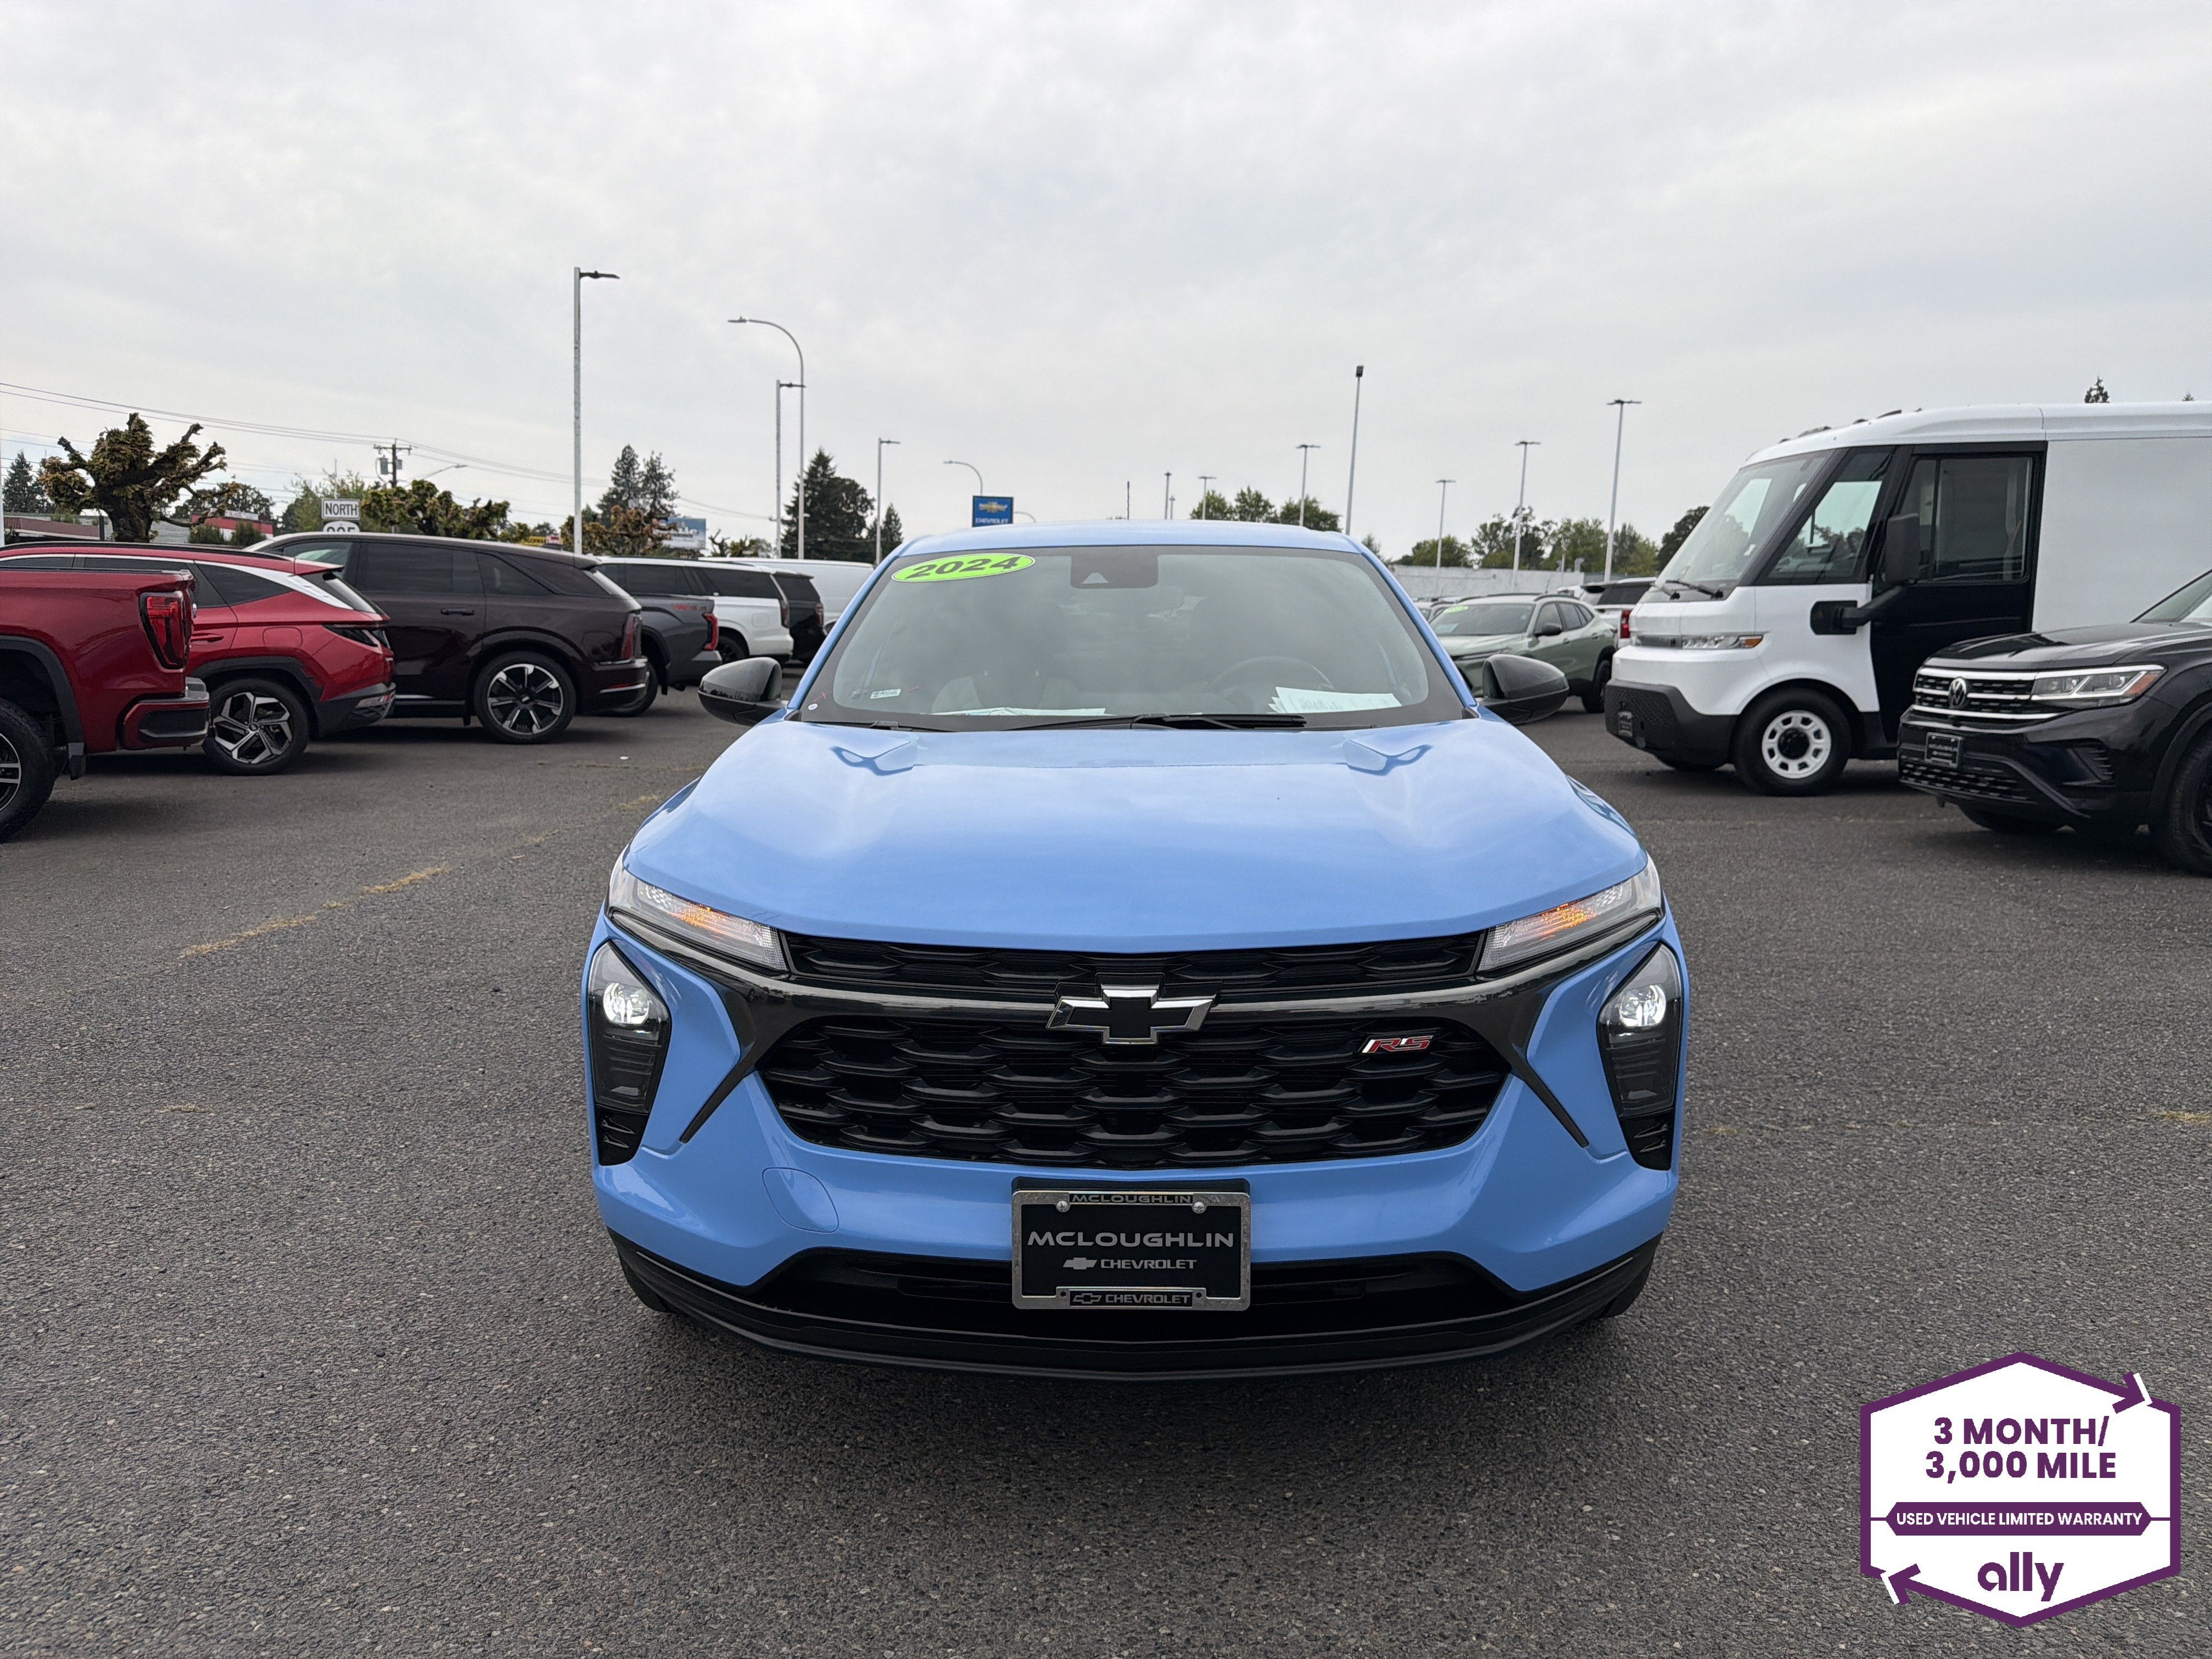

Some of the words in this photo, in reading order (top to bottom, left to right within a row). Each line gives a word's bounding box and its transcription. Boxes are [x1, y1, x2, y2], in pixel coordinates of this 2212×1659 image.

[325, 503, 357, 515] NORTH
[904, 556, 1022, 579] 2024
[1362, 1035, 1434, 1053] RS
[1071, 1194, 1192, 1204] MCLOUGHLIN
[1027, 1231, 1234, 1248] MCLOUGHLIN
[1101, 1259, 1197, 1270] CHEVROLET
[1105, 1294, 1190, 1304] CHEVROLET
